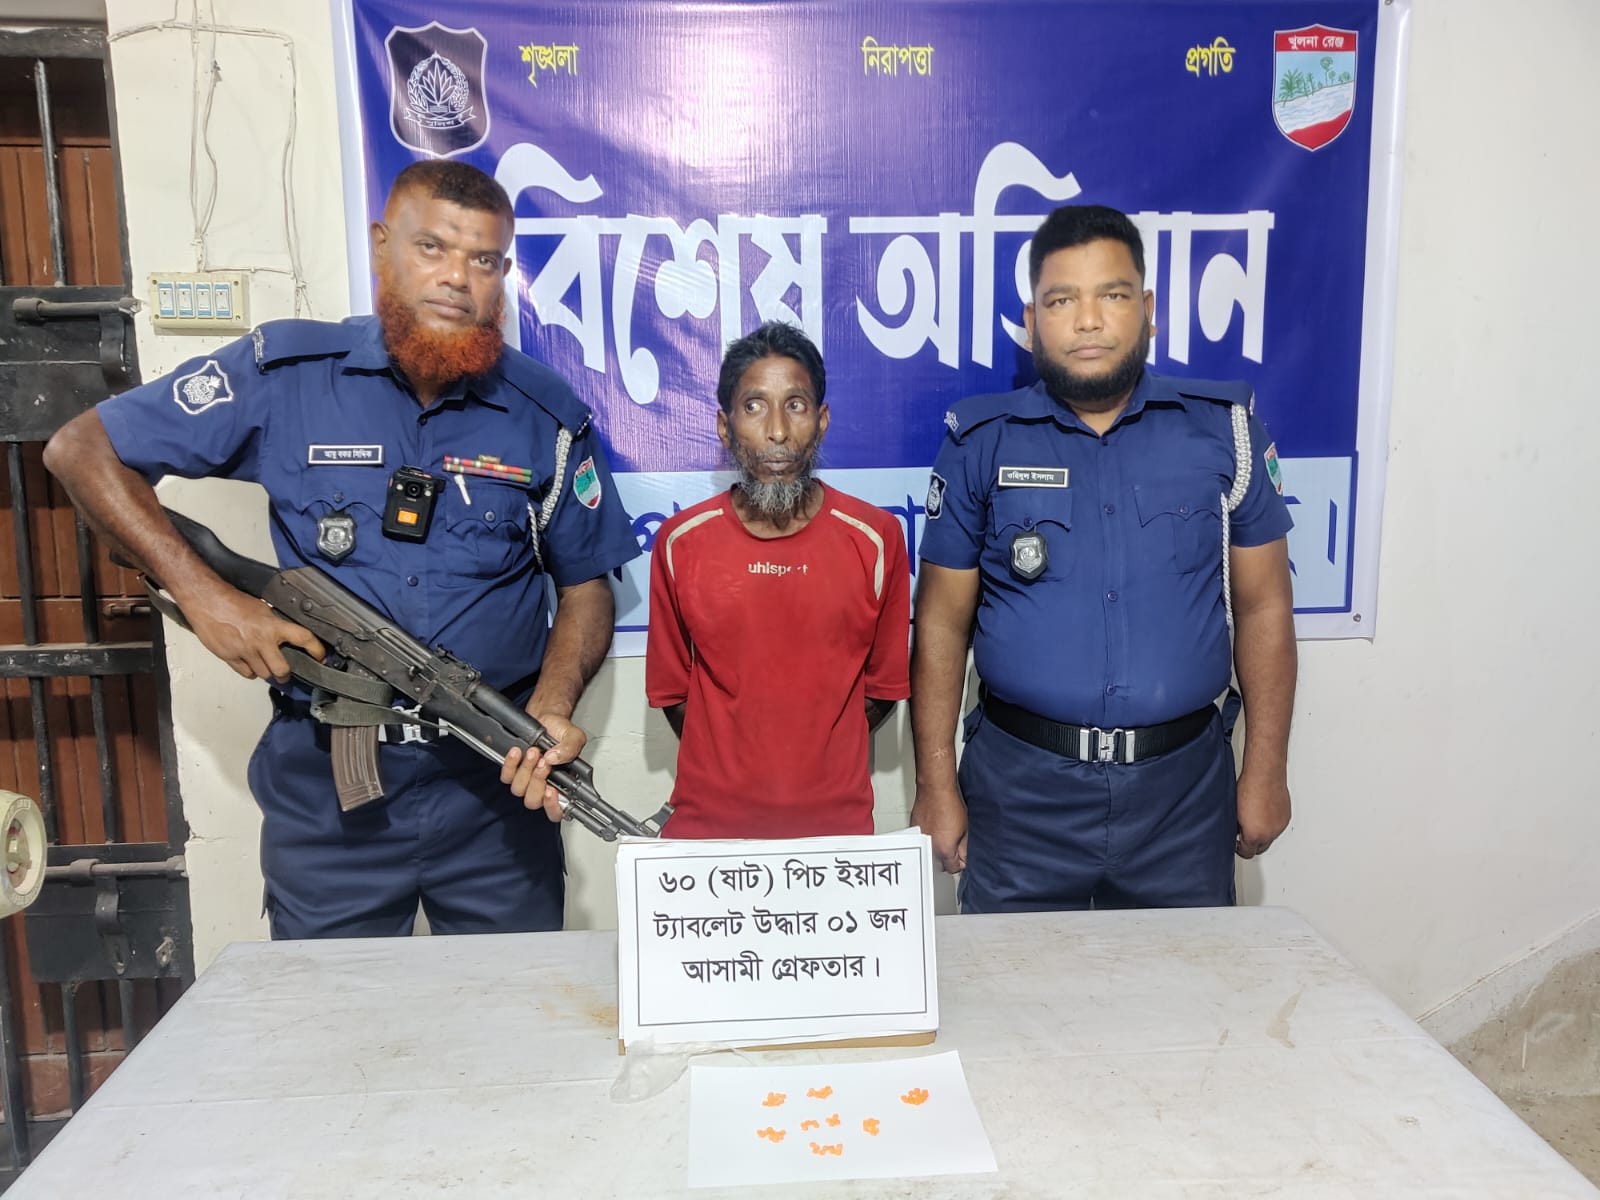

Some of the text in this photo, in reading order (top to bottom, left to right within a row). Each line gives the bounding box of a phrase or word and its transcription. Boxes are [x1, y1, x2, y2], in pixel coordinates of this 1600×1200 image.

[1288, 35, 1319, 50] খুলনা
[518, 35, 1236, 89] শৃঙ্খলা নিরাপত্তা প্রগতি
[494, 141, 1275, 404] বিশেষ অিান
[748, 561, 808, 577] uhlspt
[658, 856, 902, 899] ৬০ (ষাট) পিচ ইয়াবা
[652, 905, 909, 940] ট্যাবলেট উদ্ধার ০১ জন
[681, 949, 764, 983] আসামী
[771, 953, 866, 982] গ্রেফতার
